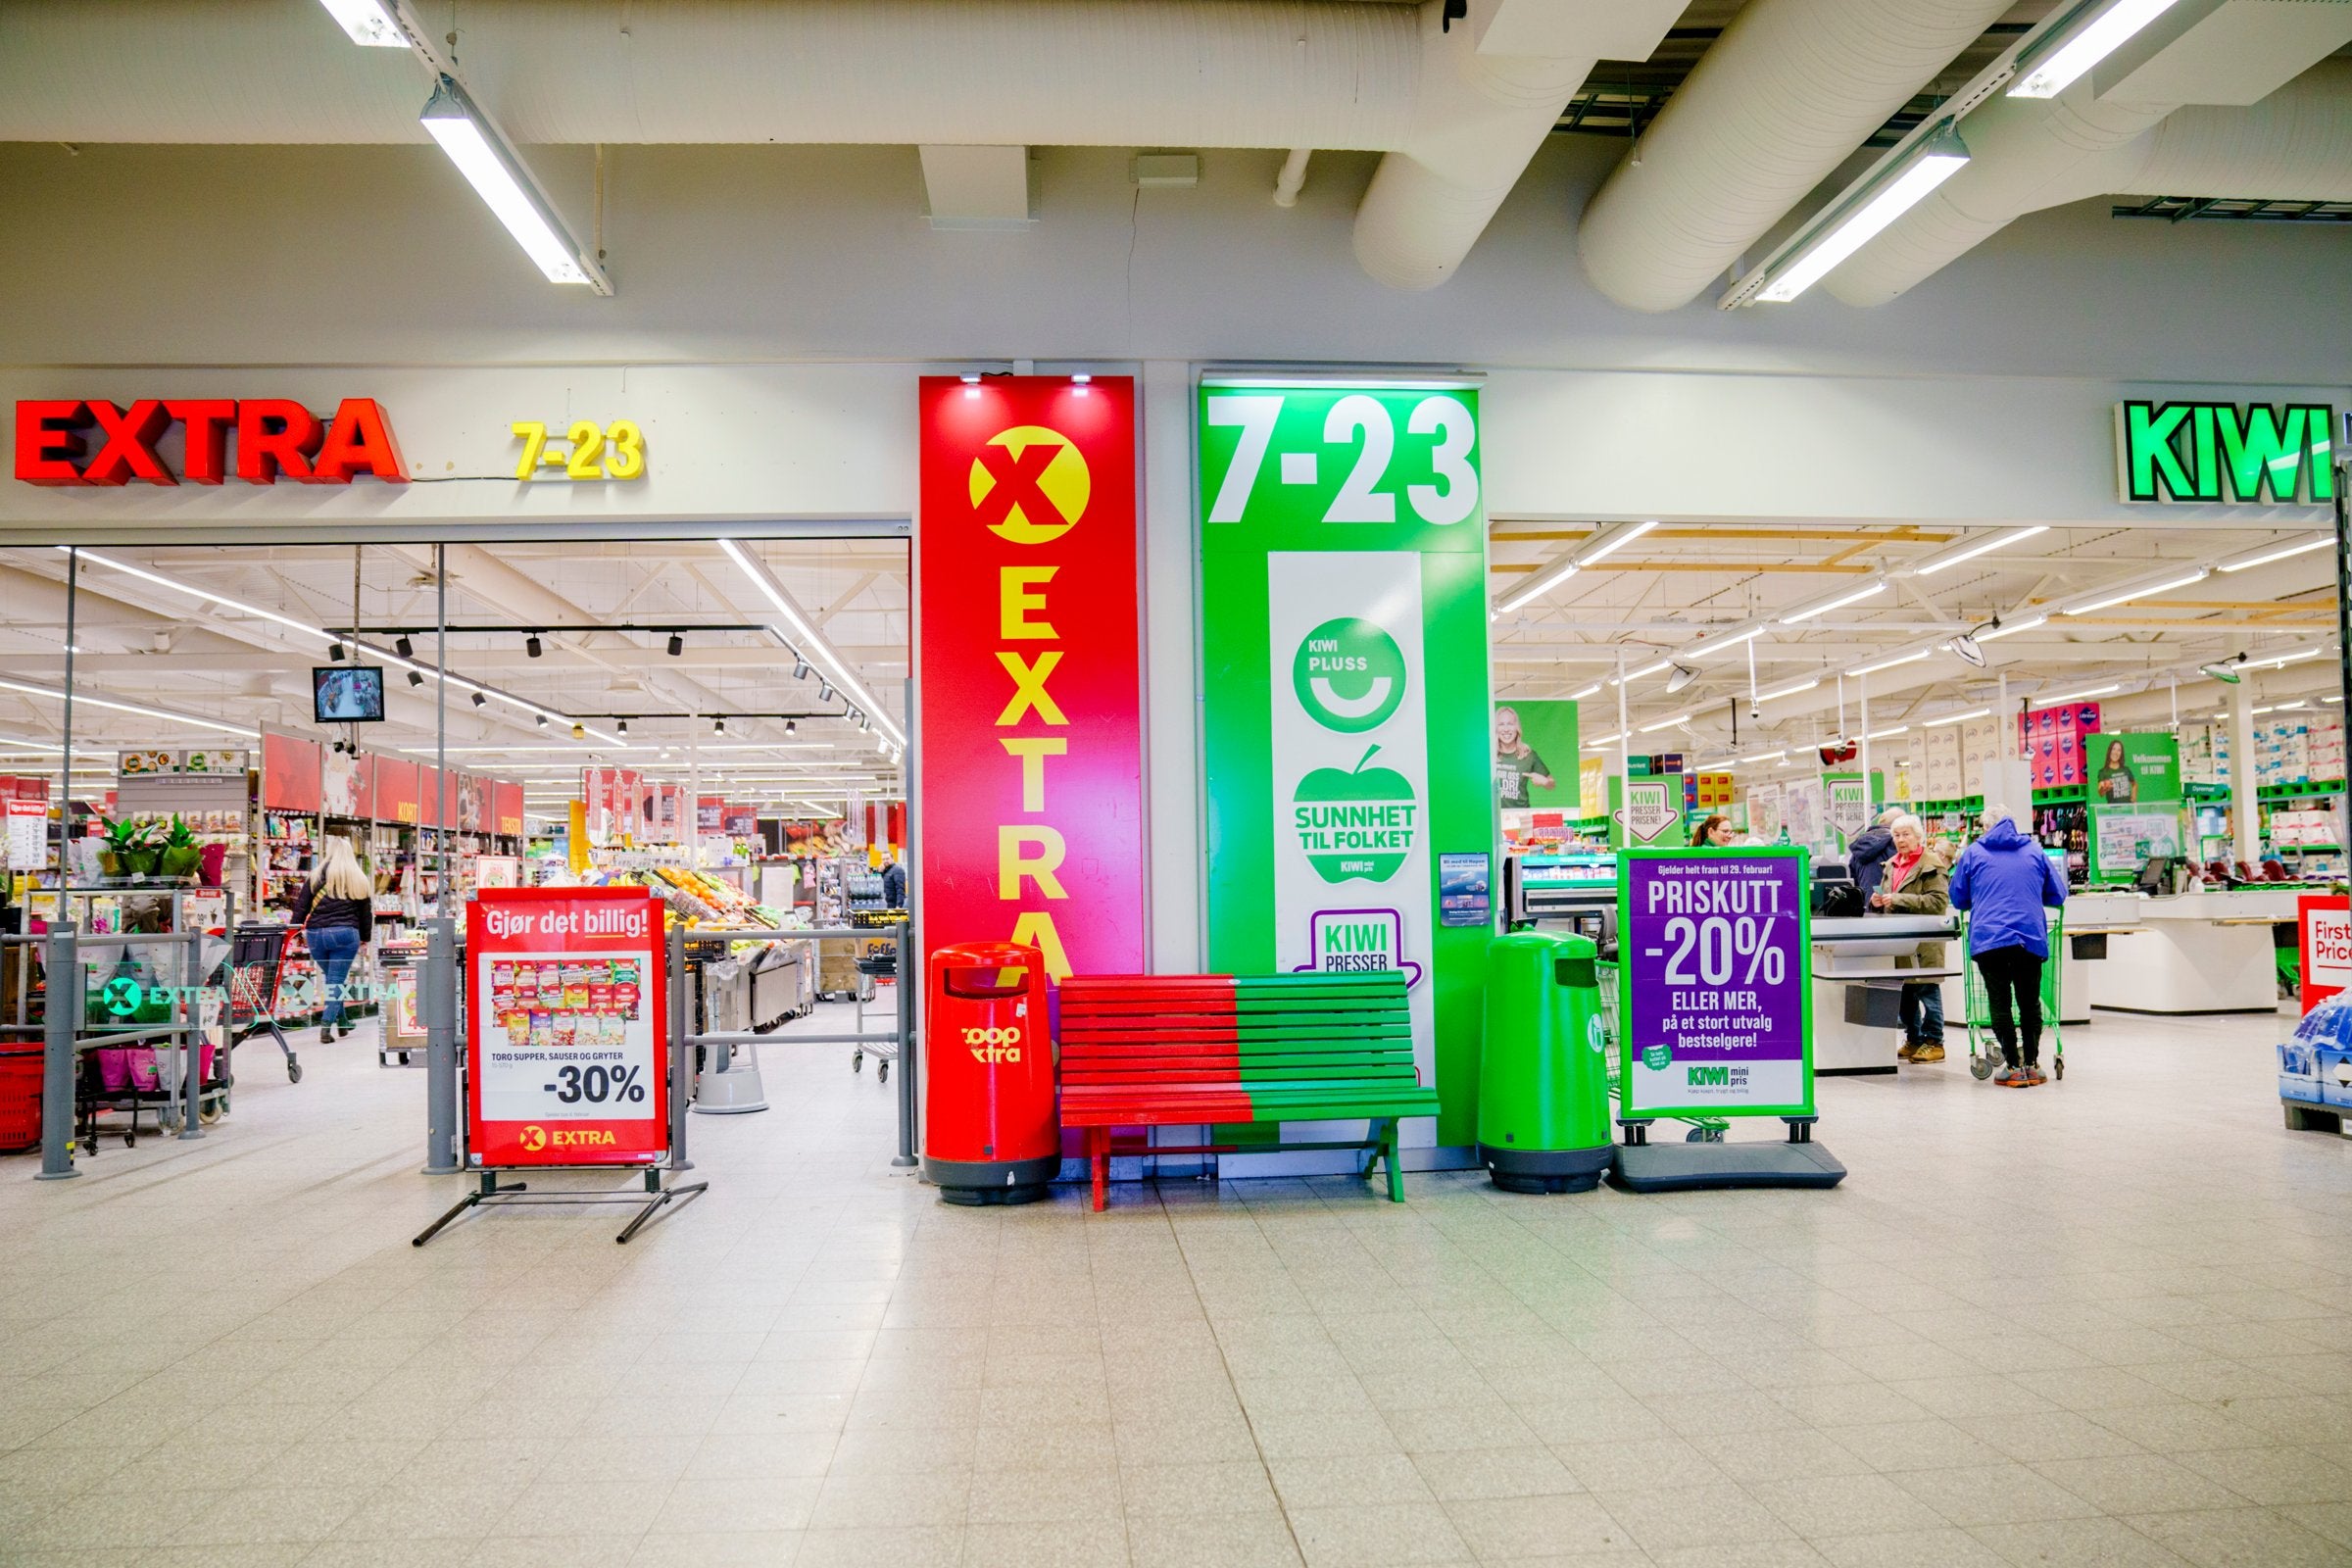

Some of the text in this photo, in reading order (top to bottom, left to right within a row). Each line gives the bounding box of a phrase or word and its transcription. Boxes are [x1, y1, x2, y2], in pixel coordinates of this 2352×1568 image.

[15, 397, 410, 485] EXTRA
[511, 419, 646, 481] 7-23
[1206, 394, 1480, 525] 7-23
[2118, 400, 2333, 504] KIWI
[1308, 639, 1339, 653] KIWI
[1309, 657, 1368, 671] PLUSS
[994, 565, 1074, 987] EXTRA
[1631, 791, 1661, 804] KIWI
[1295, 805, 1417, 829] SUNNHET
[1630, 806, 1661, 815] PRESSER
[1631, 815, 1662, 825] PRISENE!
[1298, 830, 1414, 850] TIL FOLKET
[1340, 860, 1364, 872] KIWI
[1657, 864, 1773, 876] Gjelder helt fram til 29. februar!
[1647, 879, 1784, 915] PRISKUTT
[486, 908, 649, 939] Gjør det billig!
[2315, 920, 2351, 940] First
[1325, 923, 1387, 953] KIWI
[1644, 915, 1786, 986] -20%
[1326, 954, 1388, 972] PRESSER
[149, 985, 230, 1004] EXTRA
[324, 982, 405, 1002] EXTRA
[1672, 991, 1763, 1013] ELLER MER,
[1662, 1013, 1773, 1033] på et stort utvalg
[1678, 1032, 1758, 1051] bestselgere!
[491, 1053, 513, 1061] TORO
[514, 1053, 548, 1062] SUPPER,
[548, 1052, 579, 1060] SAUSER
[592, 1052, 623, 1060] GRYTER
[544, 1064, 646, 1103] -30%
[1688, 1066, 1749, 1086] KIWI mini
[1730, 1076, 1747, 1087] pris
[552, 1130, 617, 1146] EXTRA
